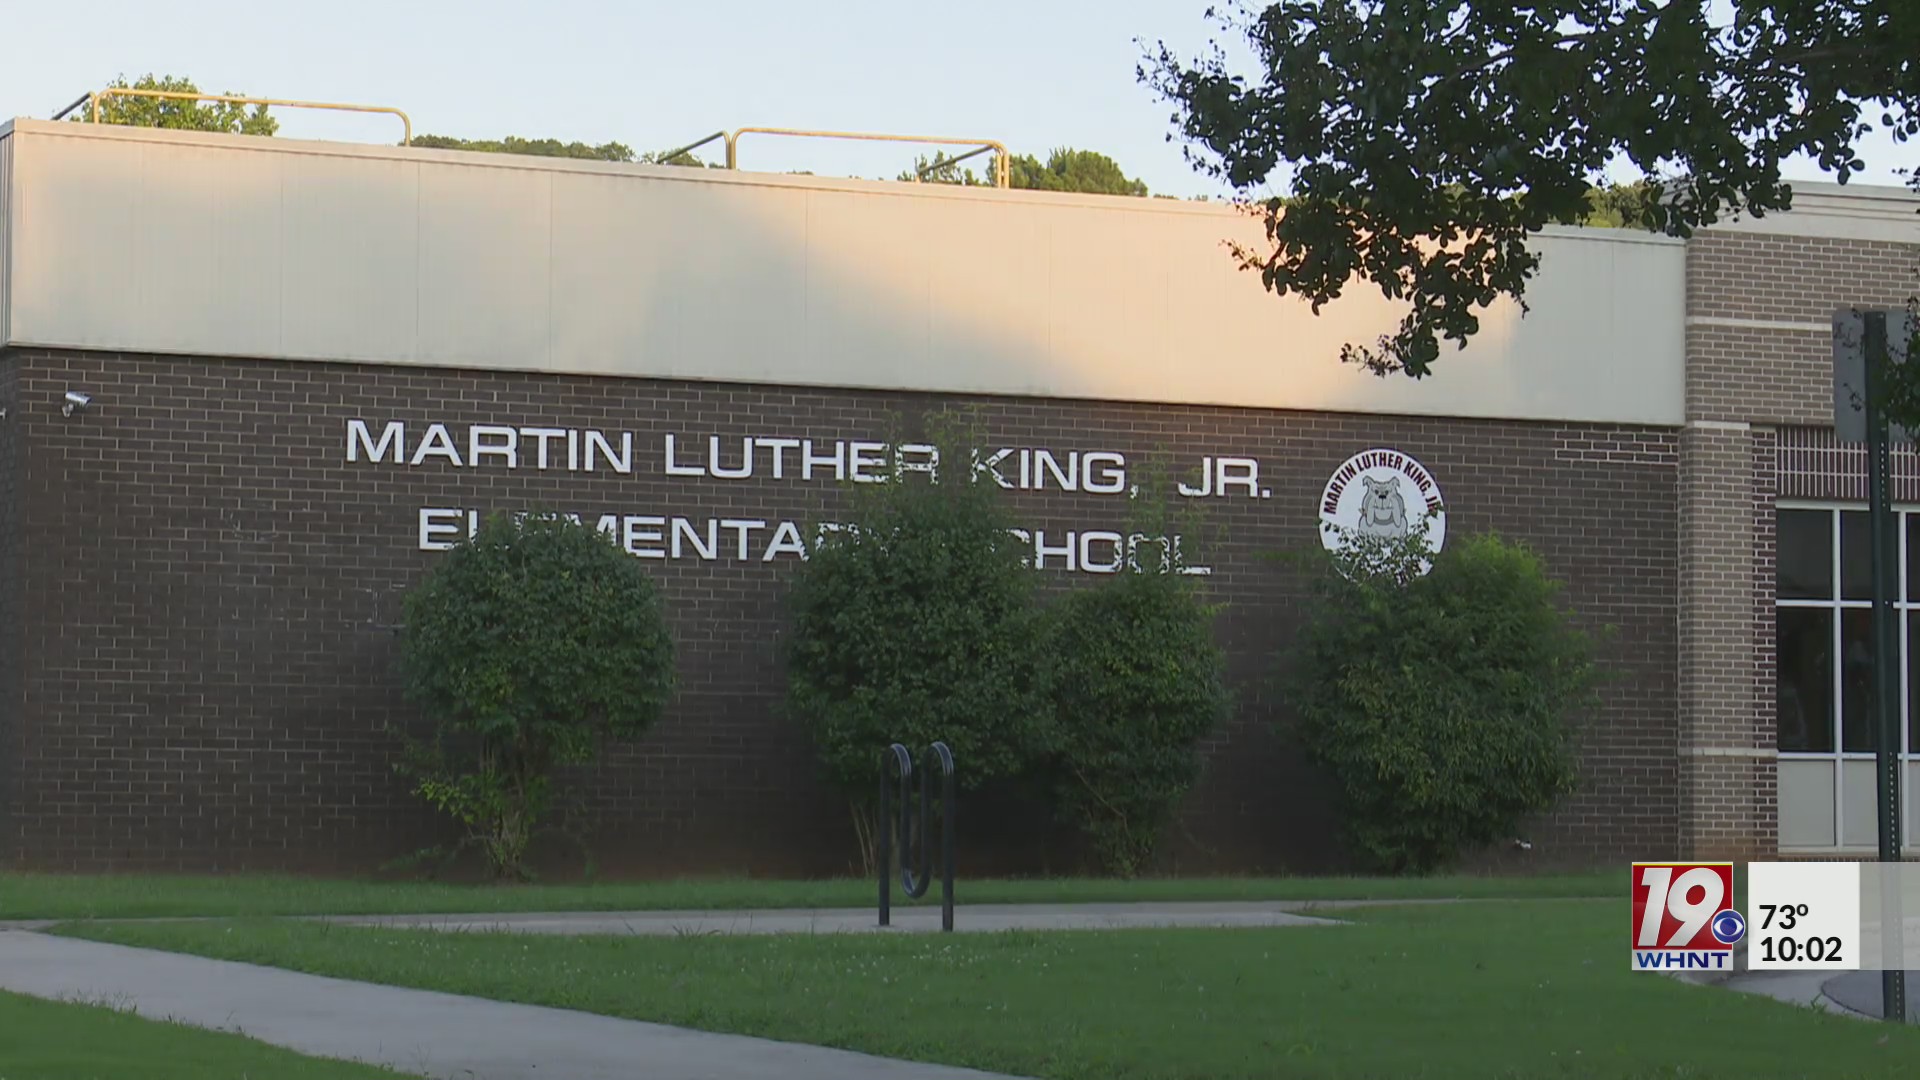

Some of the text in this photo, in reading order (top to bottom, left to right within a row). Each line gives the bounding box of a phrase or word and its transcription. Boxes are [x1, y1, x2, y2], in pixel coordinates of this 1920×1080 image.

[346, 419, 1271, 499] MARTIN LUTHER KING, JR.
[1323, 463, 1357, 515] MARTIN
[1355, 452, 1404, 473] LUTHER
